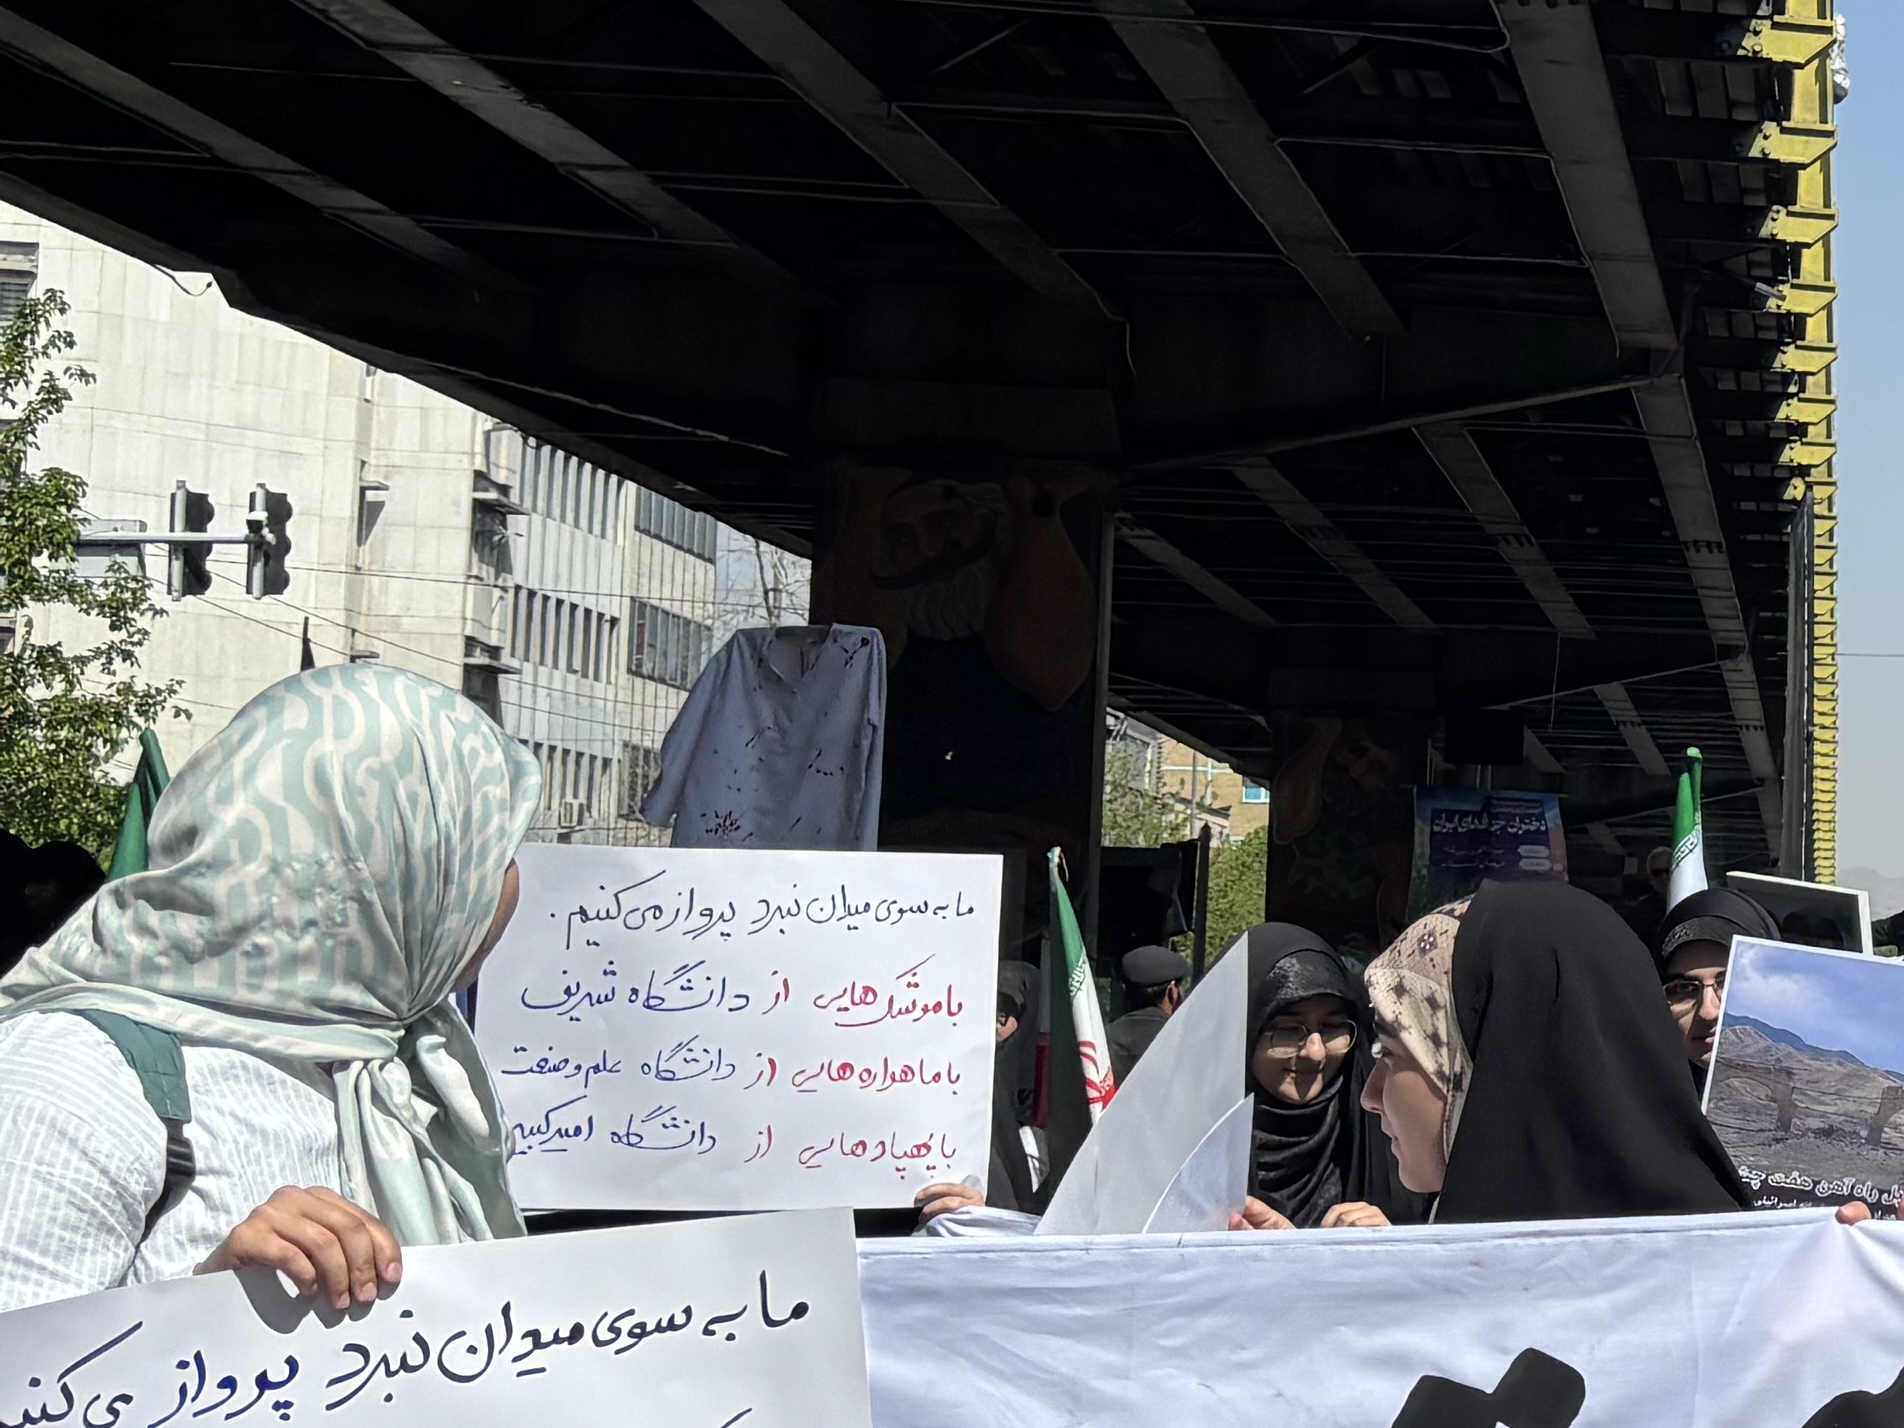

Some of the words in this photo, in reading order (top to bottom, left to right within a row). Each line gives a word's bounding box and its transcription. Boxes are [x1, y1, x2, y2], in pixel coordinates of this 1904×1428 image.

[663, 887, 736, 943] پرواز
[747, 883, 801, 935] نبرد
[806, 884, 871, 931] میدان
[874, 899, 929, 925] سوی
[932, 902, 949, 919] به
[956, 890, 975, 917] ما
[520, 959, 617, 1022] شریف
[628, 960, 750, 1013] دانشگاه
[761, 970, 789, 1016] از
[947, 983, 963, 1027] با
[500, 1045, 571, 1075] صنعت
[583, 1048, 622, 1089] علم
[640, 1035, 736, 1082] دانشگاه
[743, 1051, 777, 1093] از
[944, 1060, 962, 1095] با
[609, 1103, 718, 1154] دانشگاه
[744, 1124, 774, 1164] از
[1854, 1181, 1879, 1203] راه
[702, 1292, 756, 1344] به
[761, 1270, 811, 1326] ما
[438, 1300, 587, 1383] میدان
[598, 1303, 693, 1353] سوی
[324, 1308, 431, 1412] نبرد
